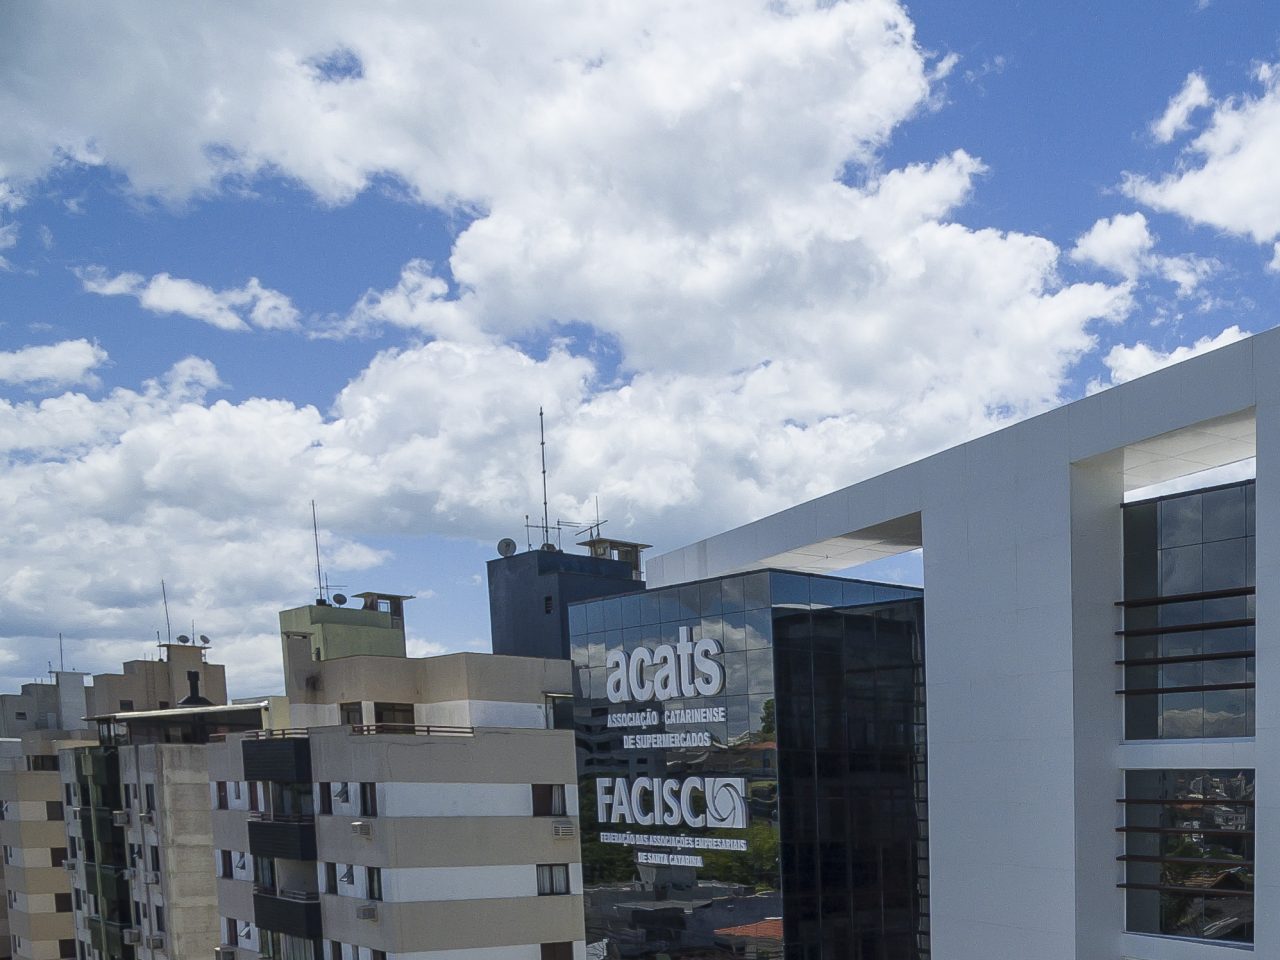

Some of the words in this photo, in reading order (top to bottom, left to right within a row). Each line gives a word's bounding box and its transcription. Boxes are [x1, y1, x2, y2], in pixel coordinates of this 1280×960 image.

[606, 626, 727, 703] acats
[607, 709, 659, 728] ASSOCIAÇÃO
[664, 707, 726, 724] CATARINENSE
[624, 734, 636, 748] DE
[636, 732, 712, 748] SUPERMERCADOS
